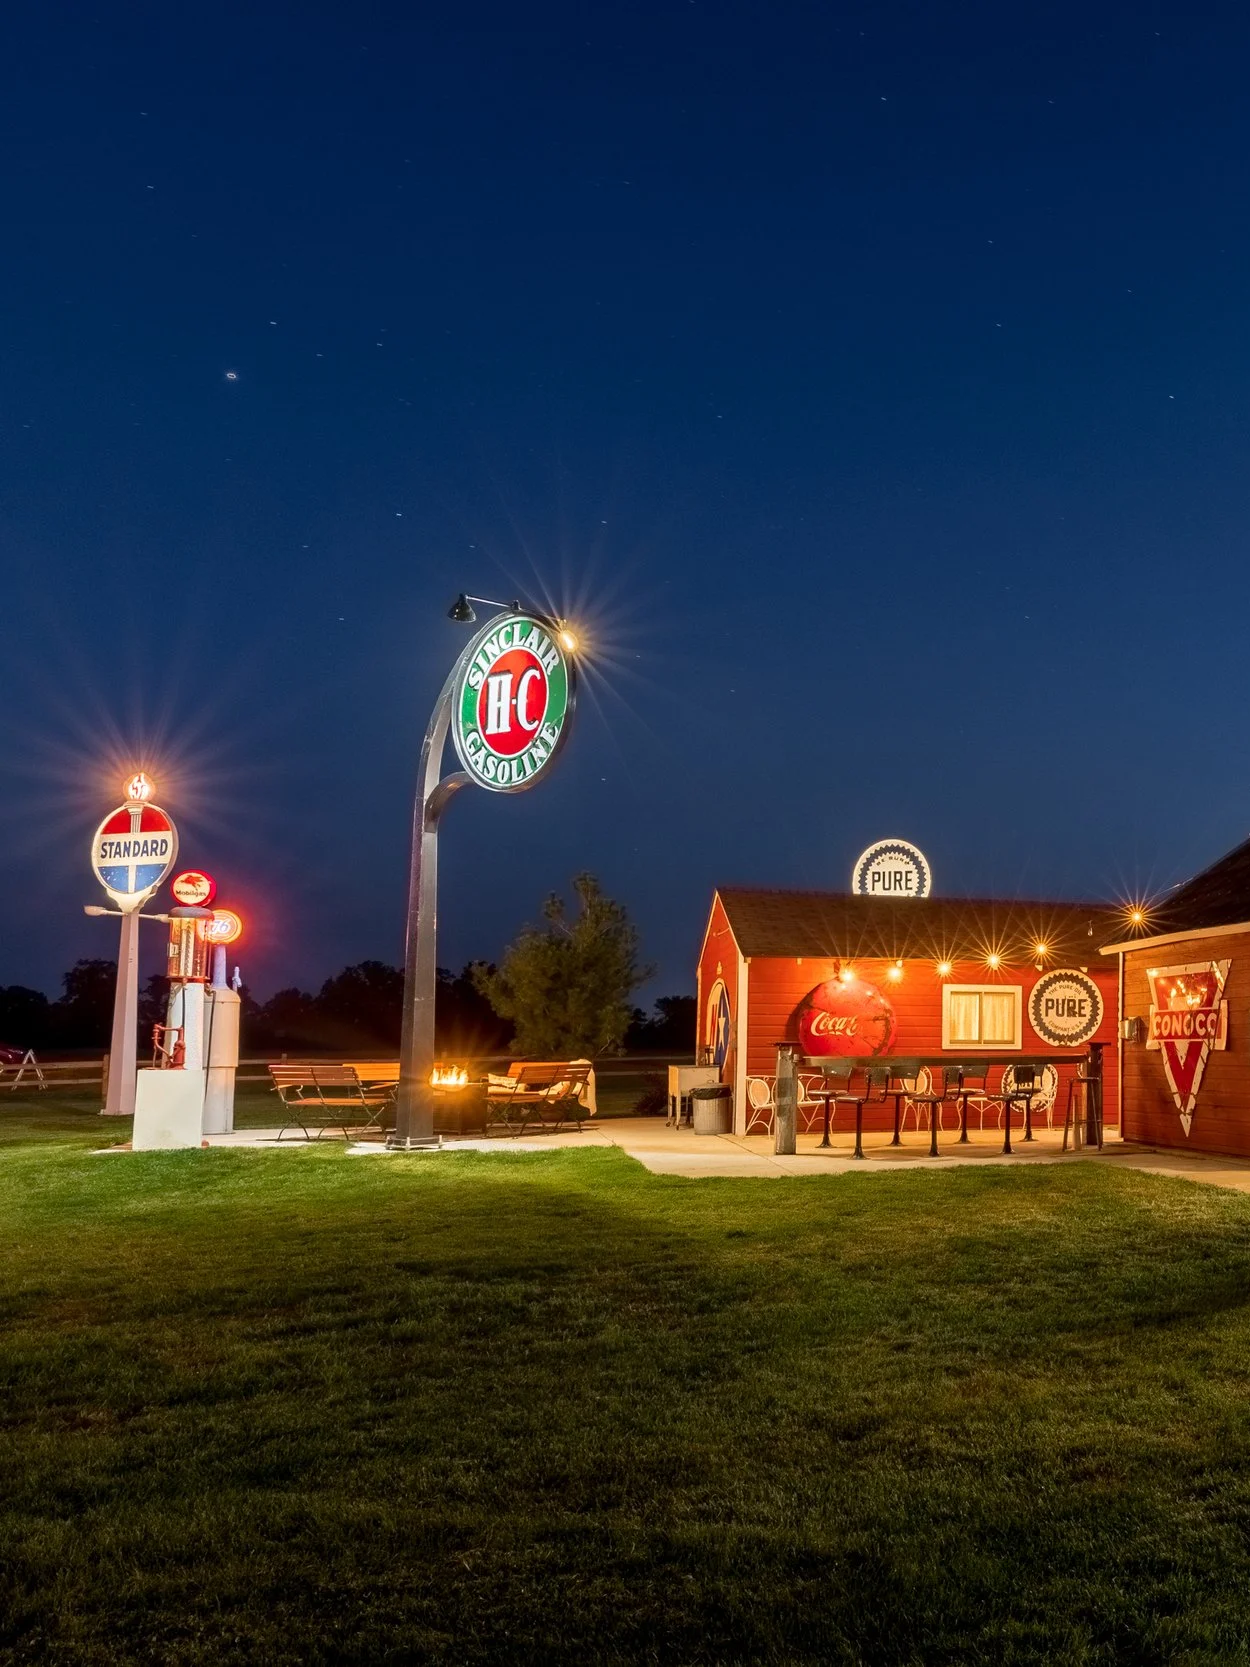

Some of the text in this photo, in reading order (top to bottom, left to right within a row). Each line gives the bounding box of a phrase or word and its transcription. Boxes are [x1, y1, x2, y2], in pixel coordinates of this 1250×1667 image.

[468, 623, 560, 691] SINCLAIR
[465, 722, 559, 784] GASOLINE
[100, 838, 169, 859] STANDARD
[872, 870, 913, 892] PURE
[175, 889, 207, 899] Mobilgas
[209, 920, 232, 935] 76
[1045, 998, 1089, 1018] PURE
[1152, 1012, 1218, 1037] CONOCO
